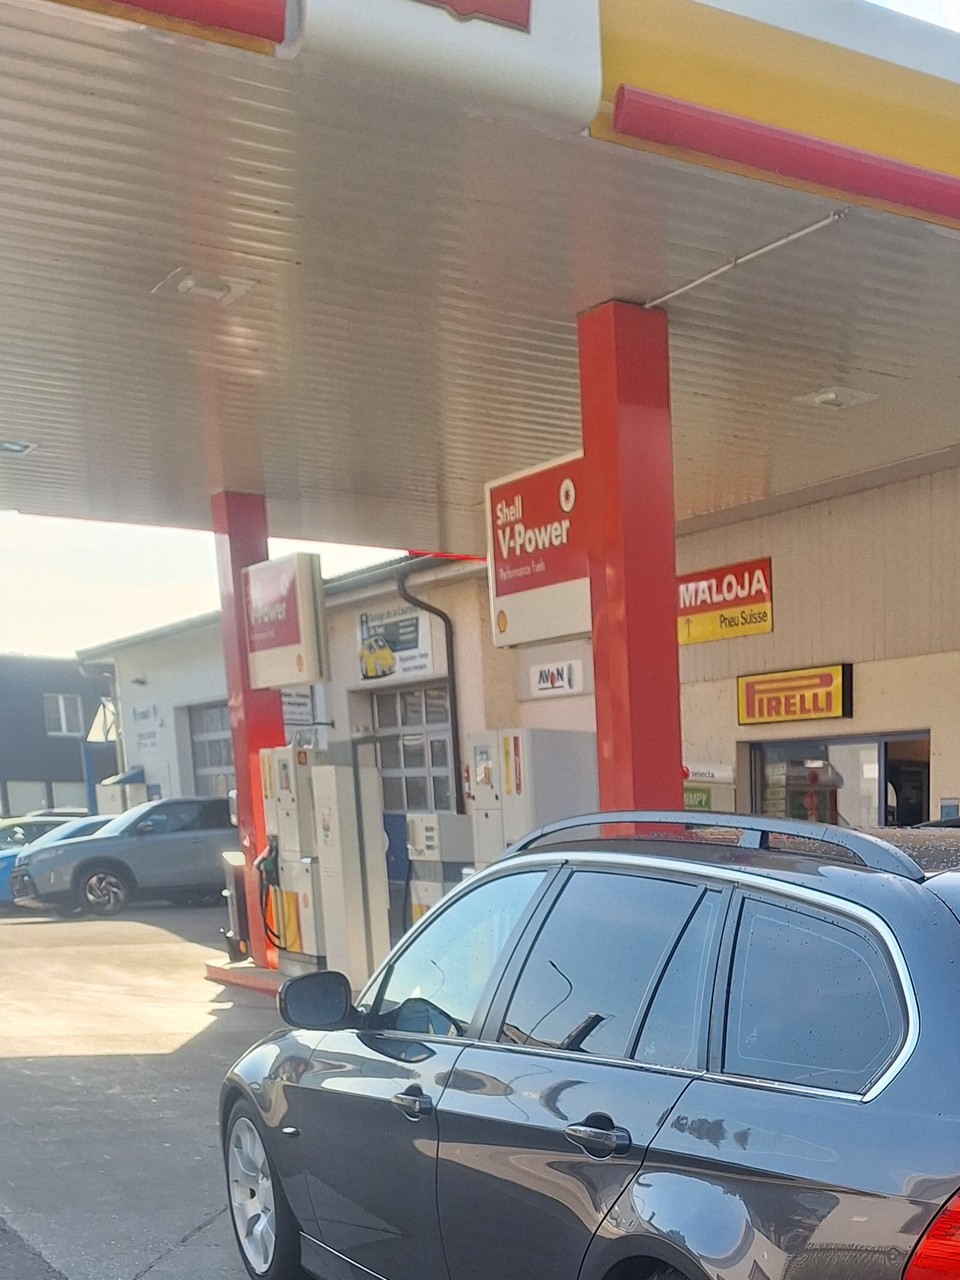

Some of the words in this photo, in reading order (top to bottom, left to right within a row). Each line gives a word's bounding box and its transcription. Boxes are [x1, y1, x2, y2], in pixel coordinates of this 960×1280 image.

[496, 494, 522, 526] Shell
[498, 519, 571, 560] V-Power
[679, 569, 768, 609] MALOJA
[719, 613, 739, 629] Pneu
[740, 609, 768, 626] Suisse
[745, 673, 833, 719] PIRELLI
